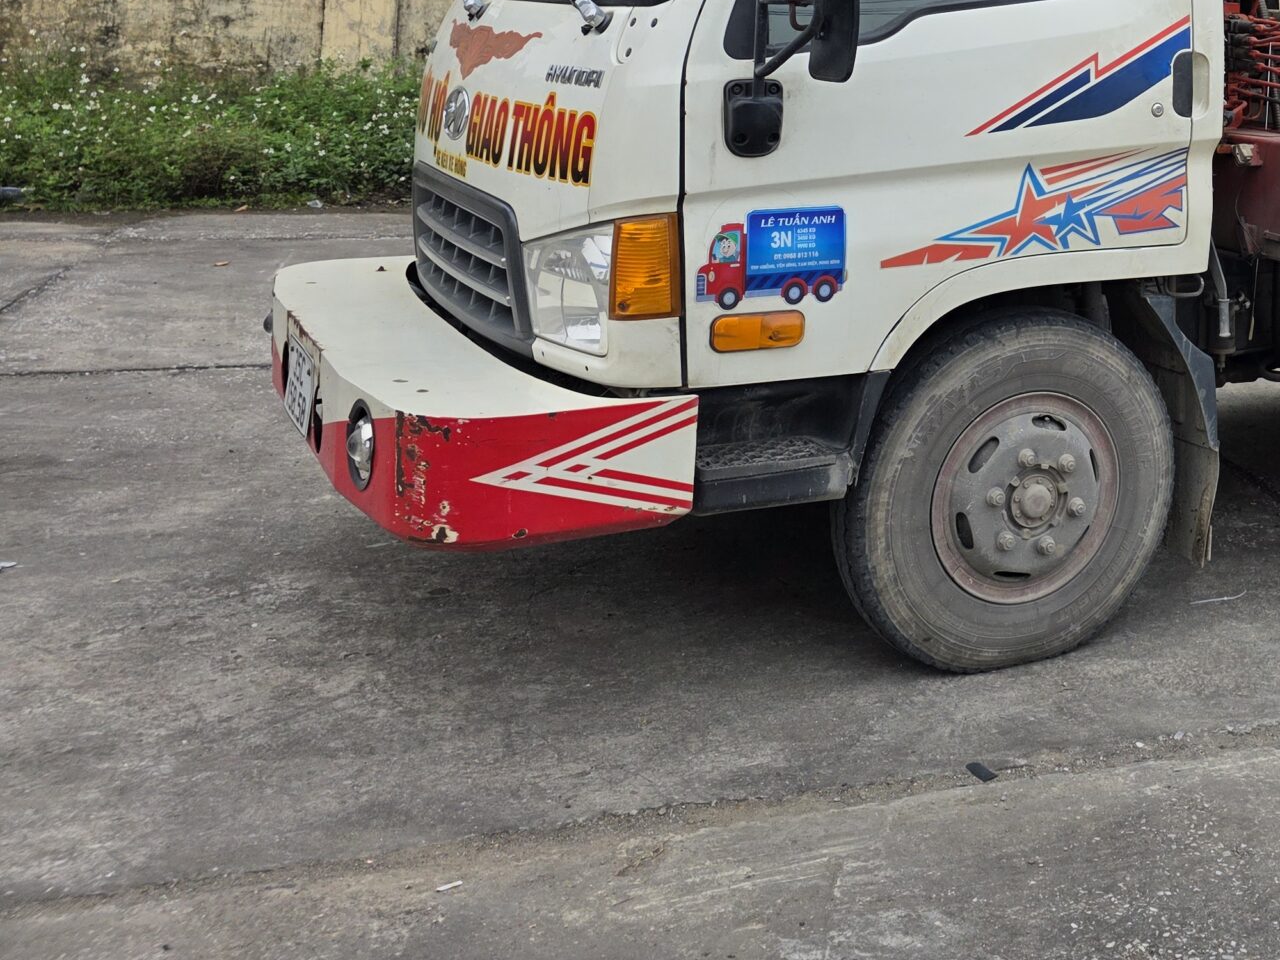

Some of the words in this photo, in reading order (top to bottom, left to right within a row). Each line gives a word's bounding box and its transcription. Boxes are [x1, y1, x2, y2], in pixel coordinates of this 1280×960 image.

[545, 64, 605, 89] HYUNDAI
[465, 91, 511, 169] GIAO
[507, 91, 597, 187] THÔNG
[760, 216, 775, 228] LÊ
[777, 212, 809, 226] TUẤN
[811, 215, 836, 225] ANH
[770, 230, 791, 249] 3N
[809, 250, 819, 258] 116
